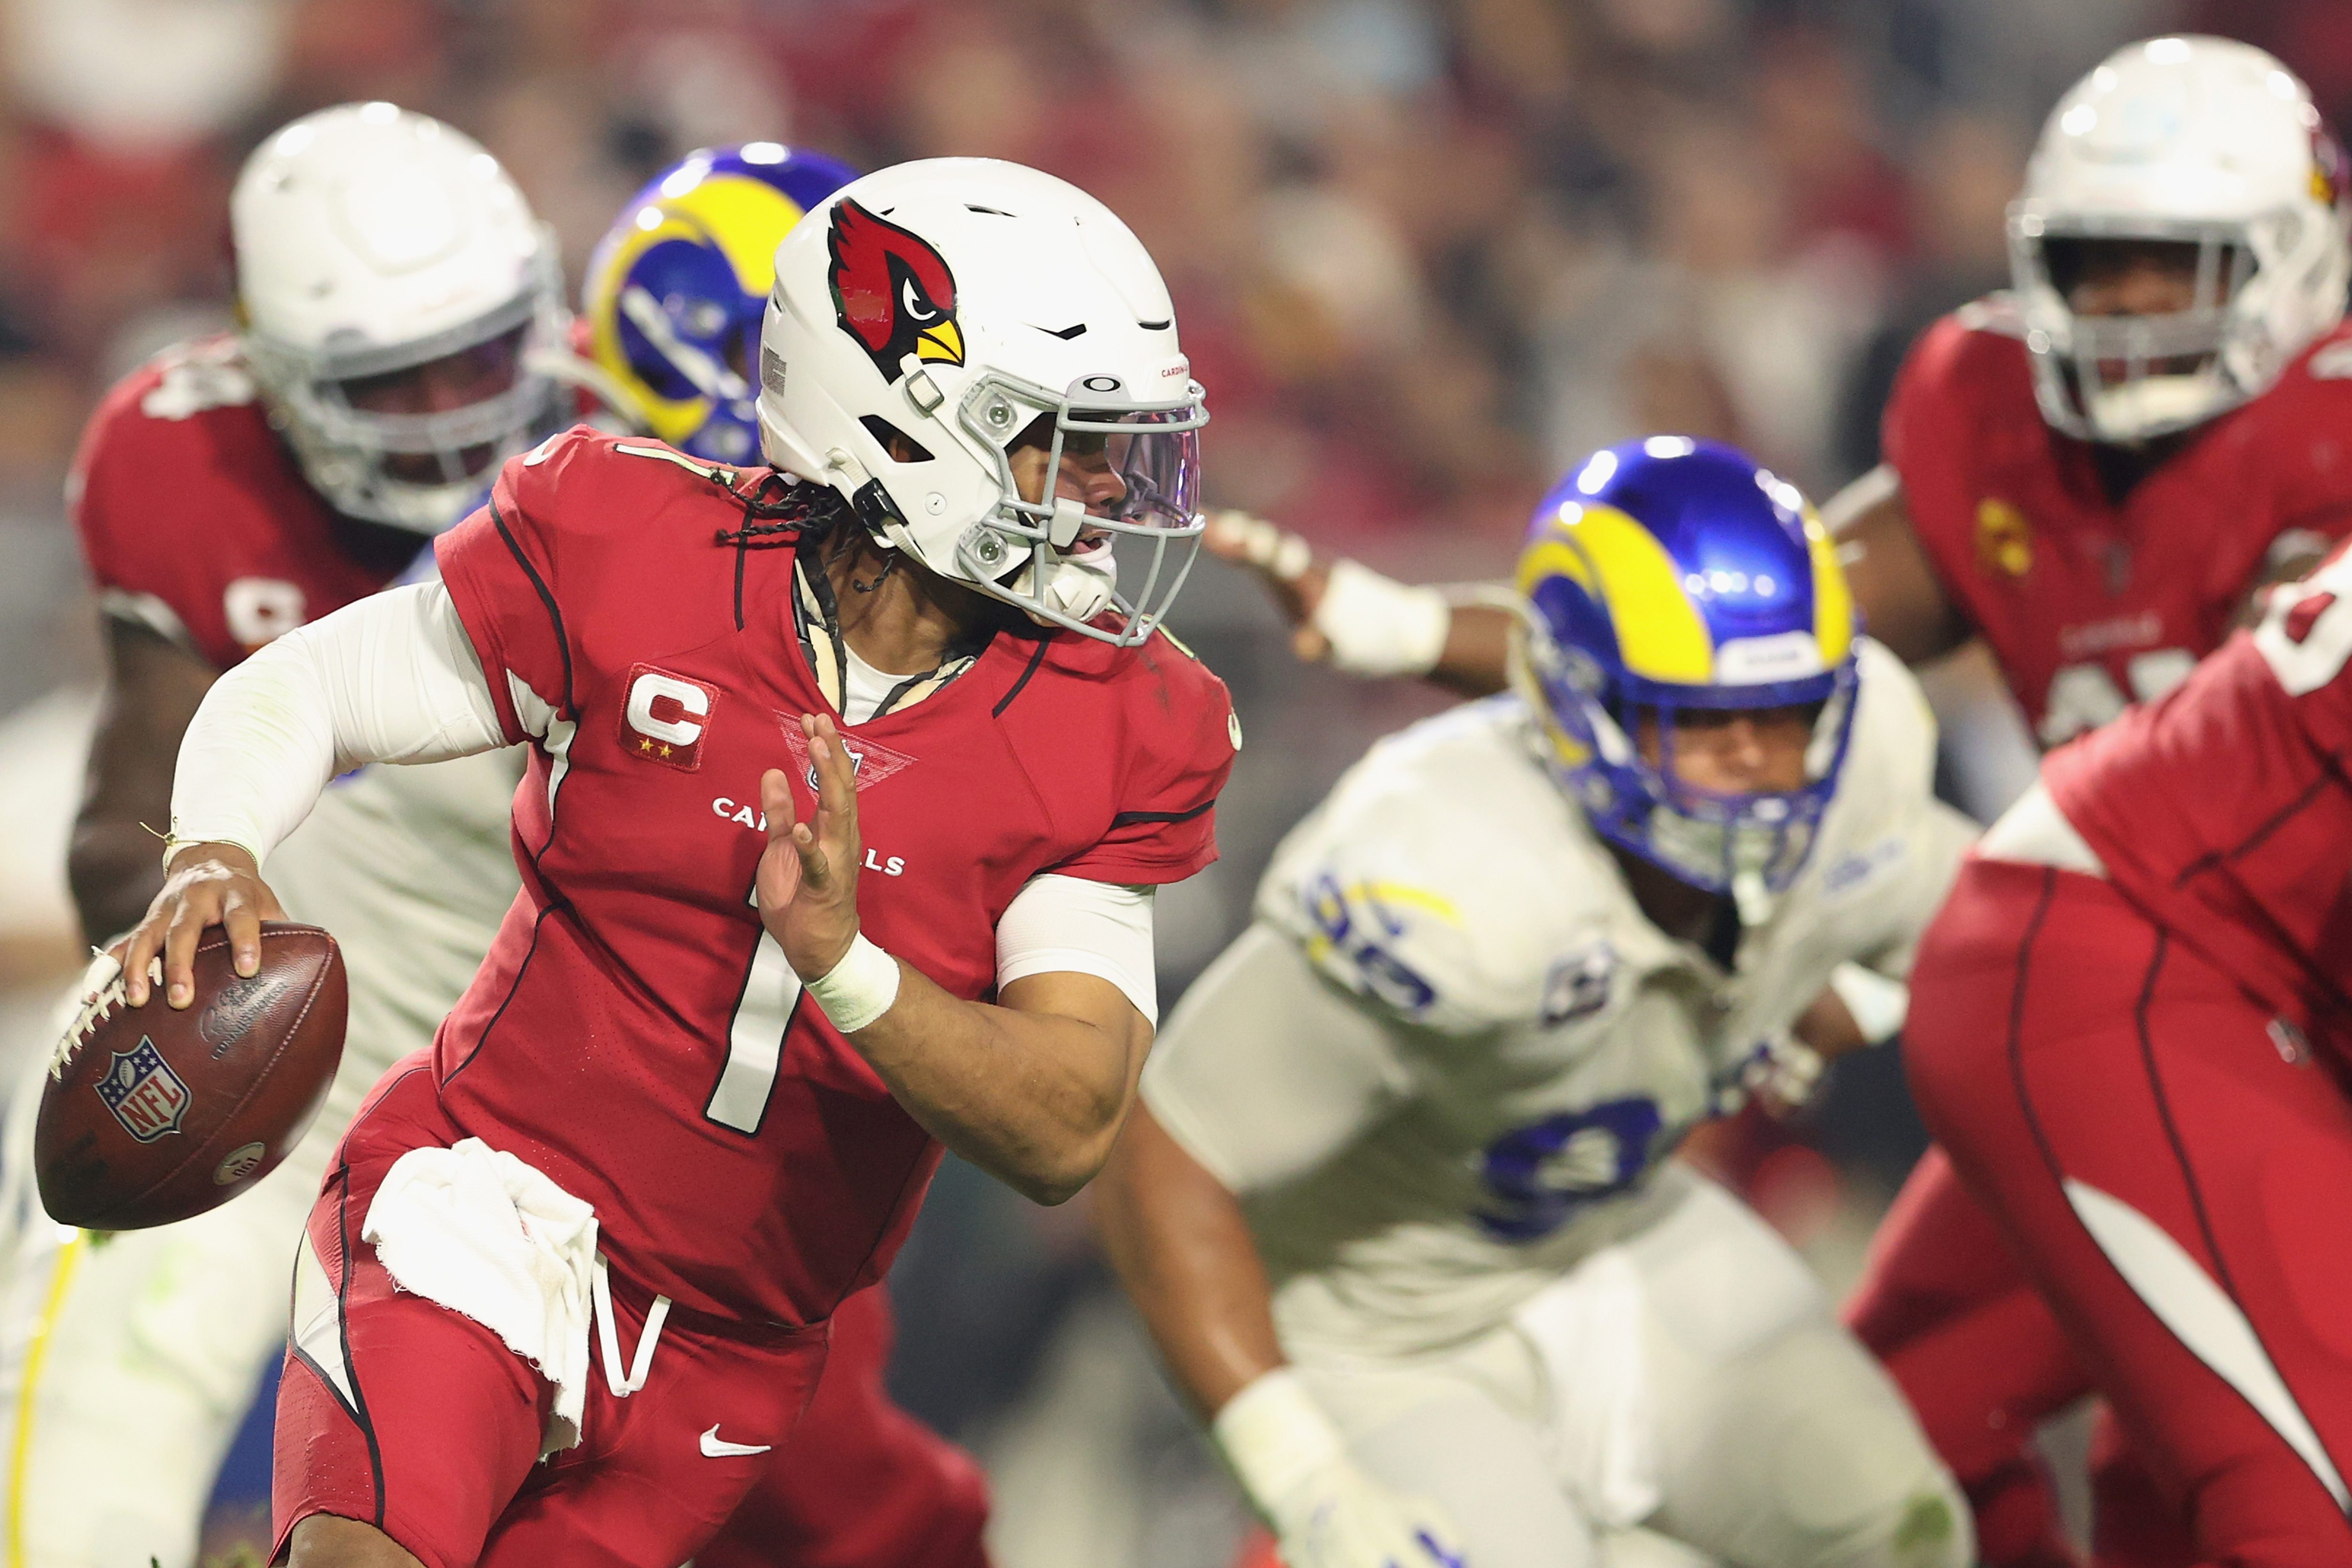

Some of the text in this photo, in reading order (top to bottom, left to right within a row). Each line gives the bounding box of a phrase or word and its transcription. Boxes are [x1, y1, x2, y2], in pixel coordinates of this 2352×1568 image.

[627, 673, 709, 746] C
[703, 875, 802, 1136] 1
[119, 1075, 181, 1134] NFL
